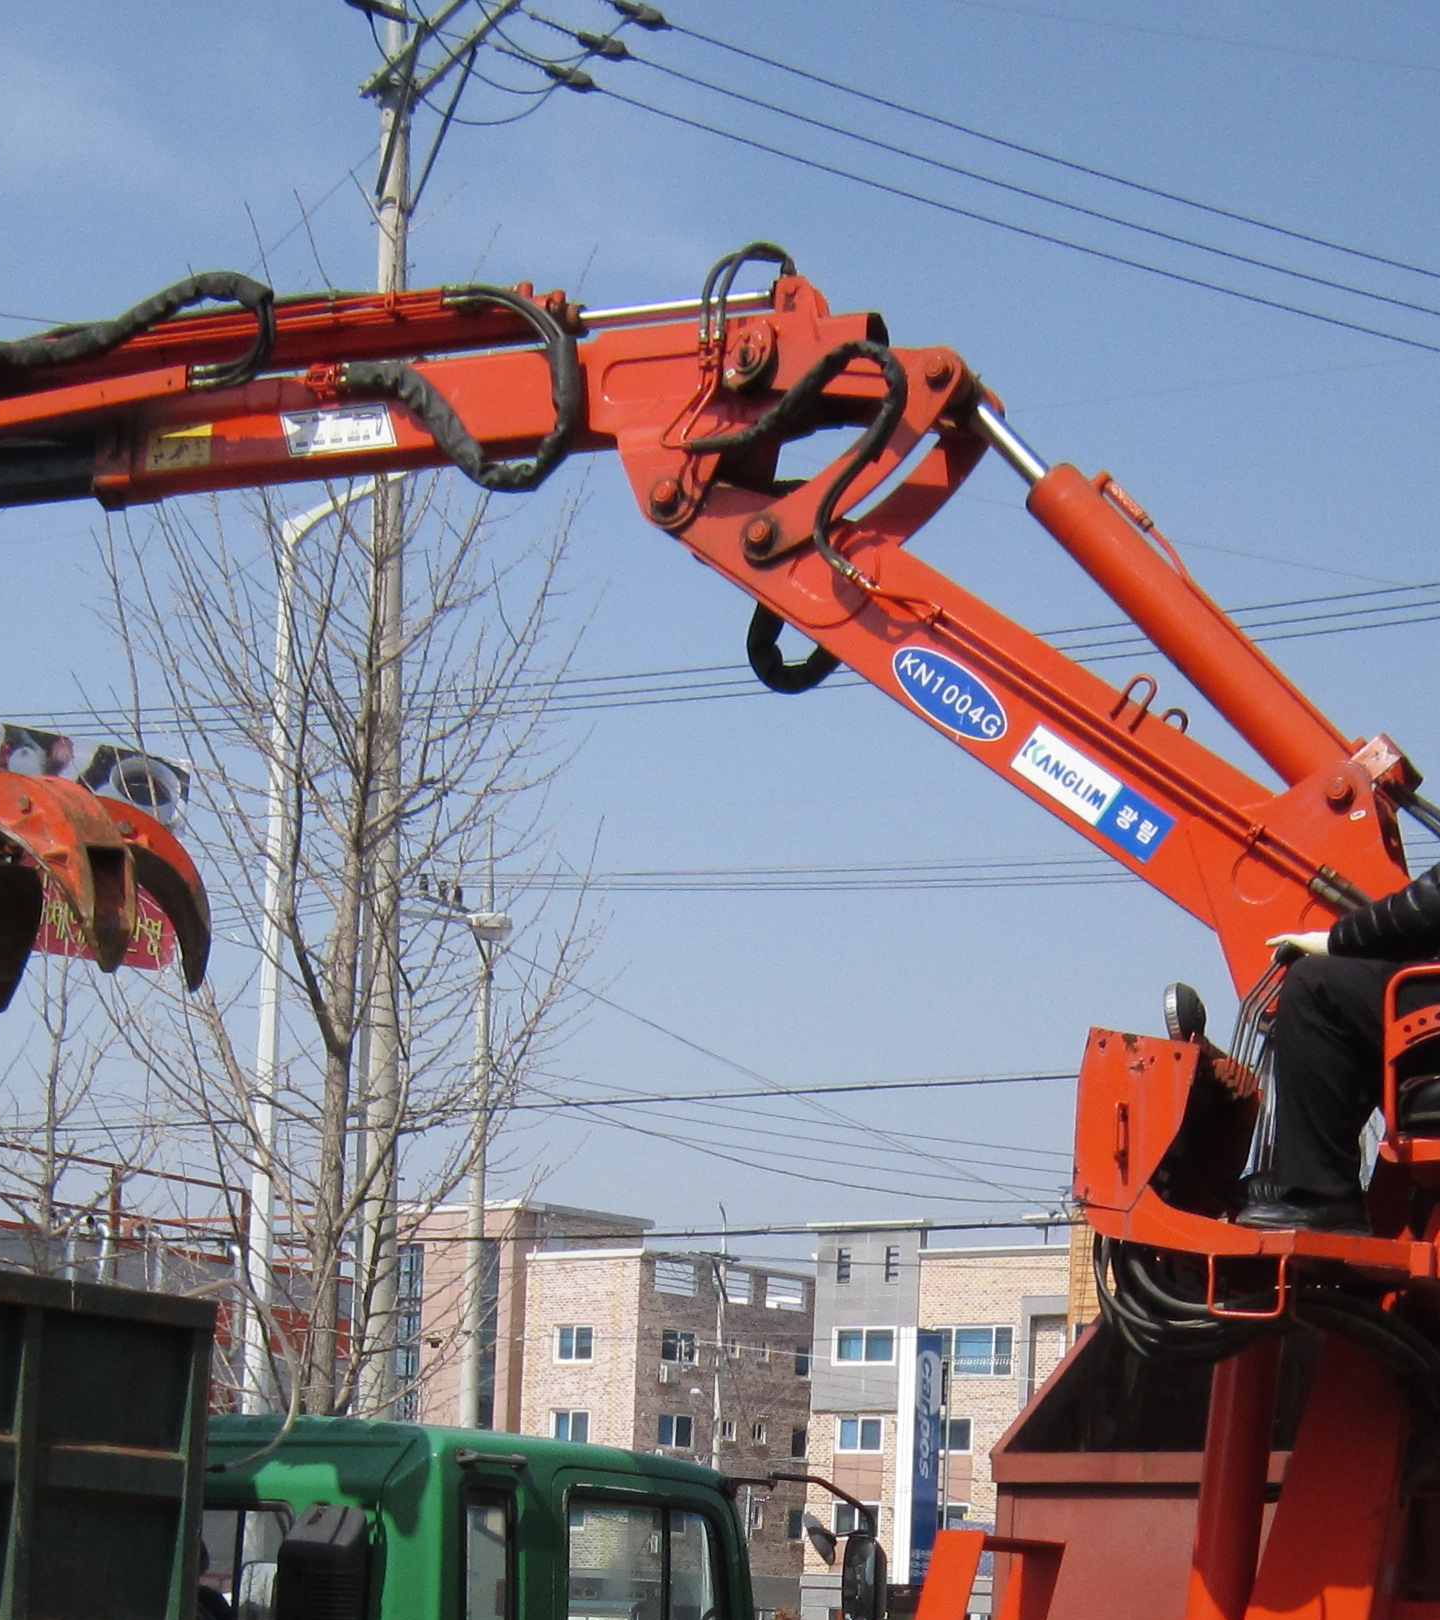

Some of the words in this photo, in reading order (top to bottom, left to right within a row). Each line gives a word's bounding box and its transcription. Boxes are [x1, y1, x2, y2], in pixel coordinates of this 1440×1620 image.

[899, 651, 1002, 738] KN1004G
[1021, 738, 1108, 812] KANGLIM
[1116, 804, 1159, 845] 광림
[917, 1356, 933, 1480] carpos
